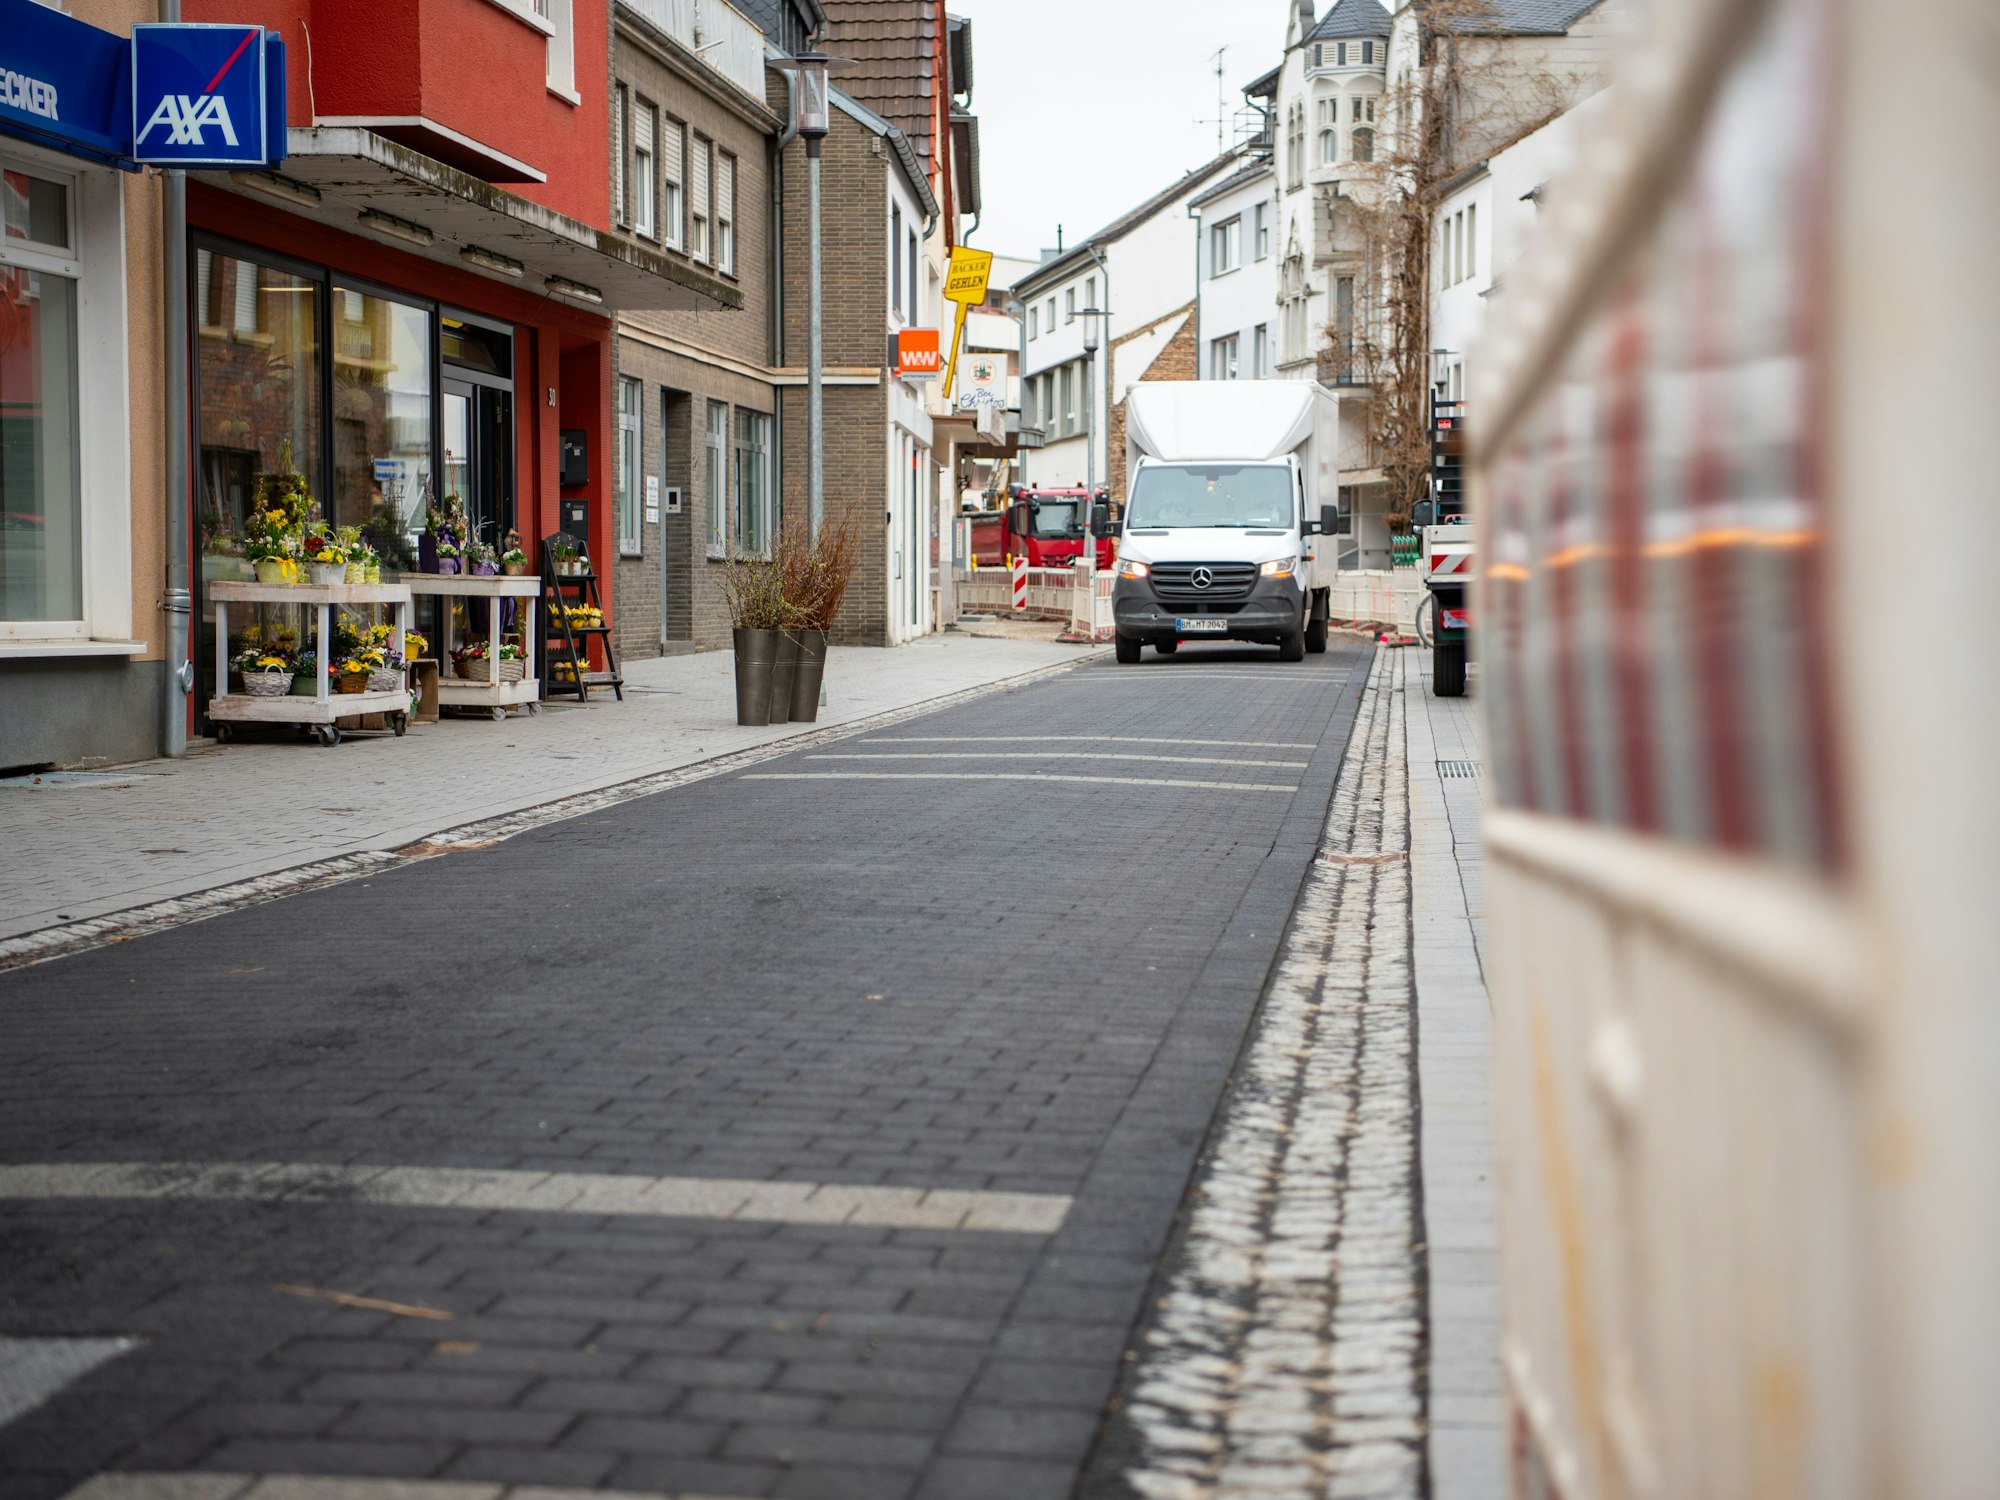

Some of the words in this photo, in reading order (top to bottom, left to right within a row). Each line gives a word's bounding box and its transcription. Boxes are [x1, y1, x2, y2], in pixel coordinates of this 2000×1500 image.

[136, 94, 240, 146] AXA
[950, 275, 985, 290] GEHLEN
[901, 350, 938, 367] W&W
[548, 387, 556, 407] 30
